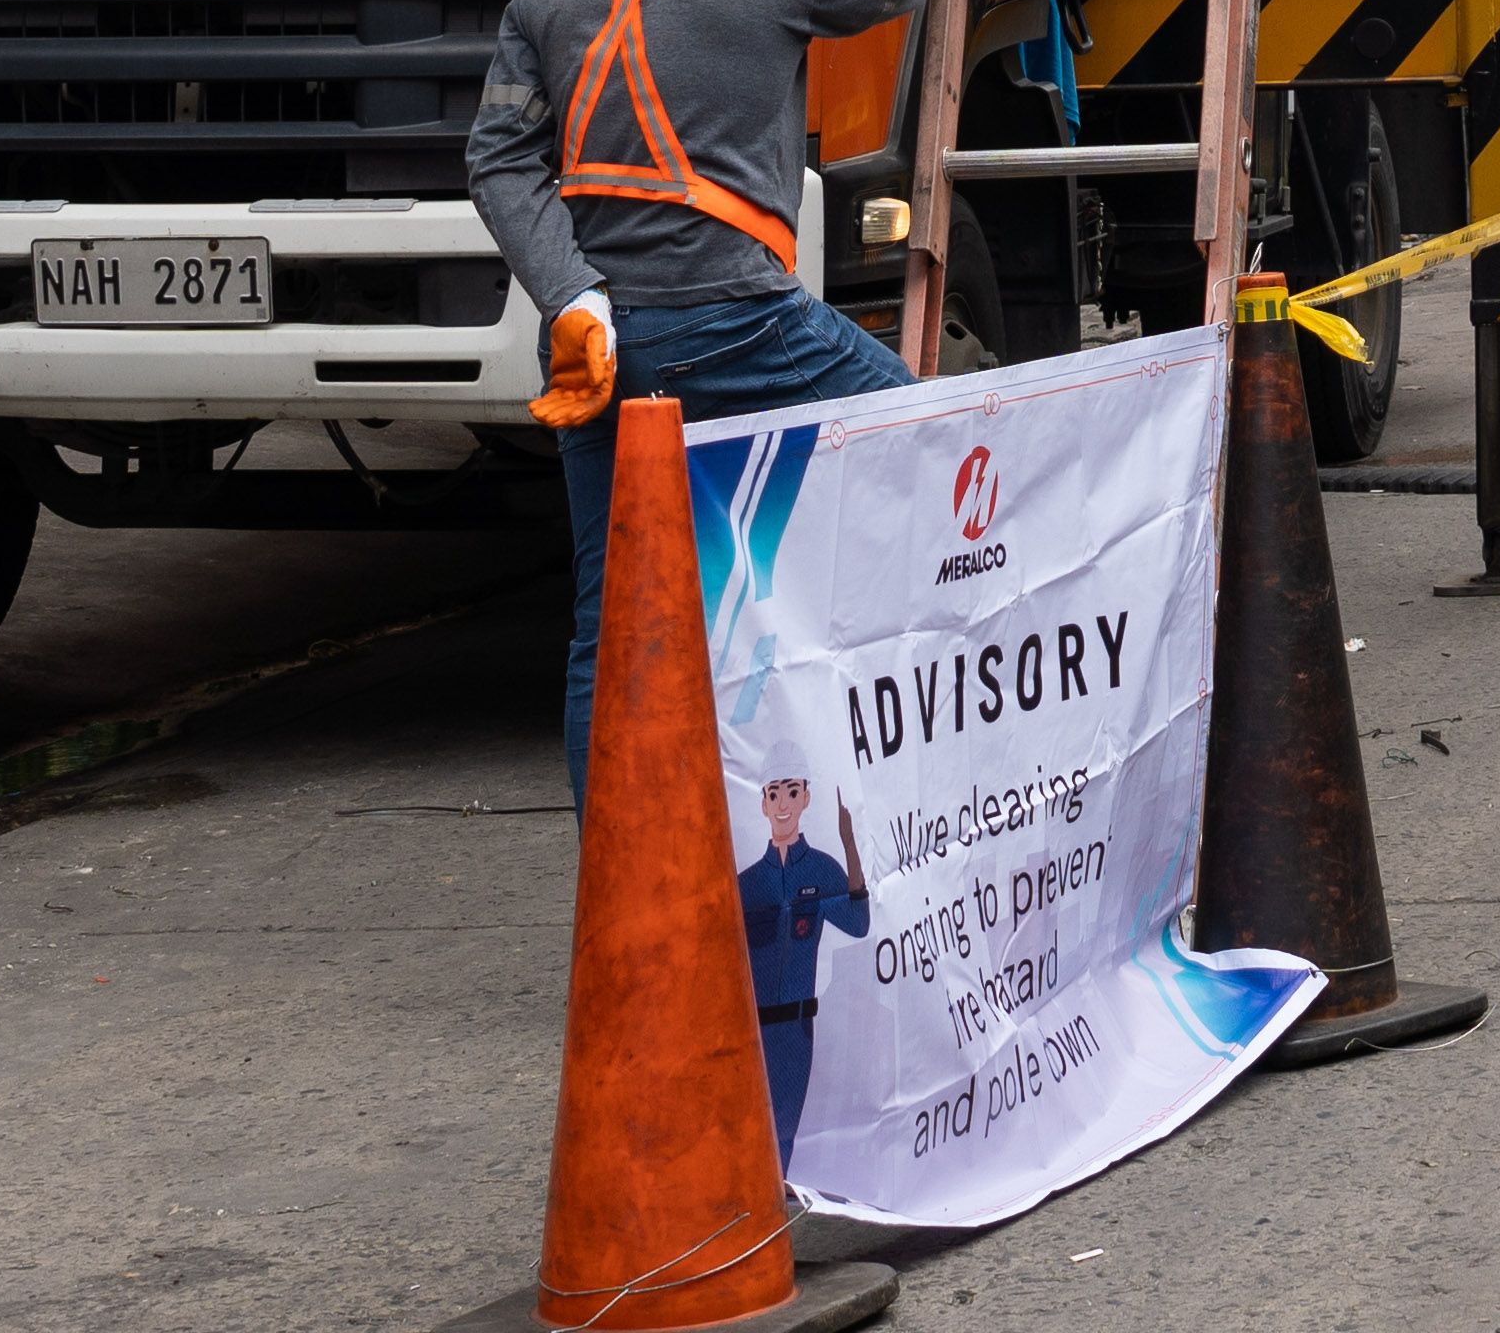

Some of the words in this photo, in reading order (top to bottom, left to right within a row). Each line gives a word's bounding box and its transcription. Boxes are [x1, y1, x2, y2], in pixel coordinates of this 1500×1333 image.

[40, 255, 121, 307] NAH
[154, 254, 263, 305] 2871
[934, 543, 1007, 586] MERALCO
[848, 611, 1129, 770] ADVISORY
[890, 808, 949, 875] Wire
[957, 765, 1090, 848] clearing
[973, 876, 999, 933] to
[979, 930, 1059, 1025] hazard
[913, 1075, 976, 1159] and
[984, 1044, 1043, 1139] pole
